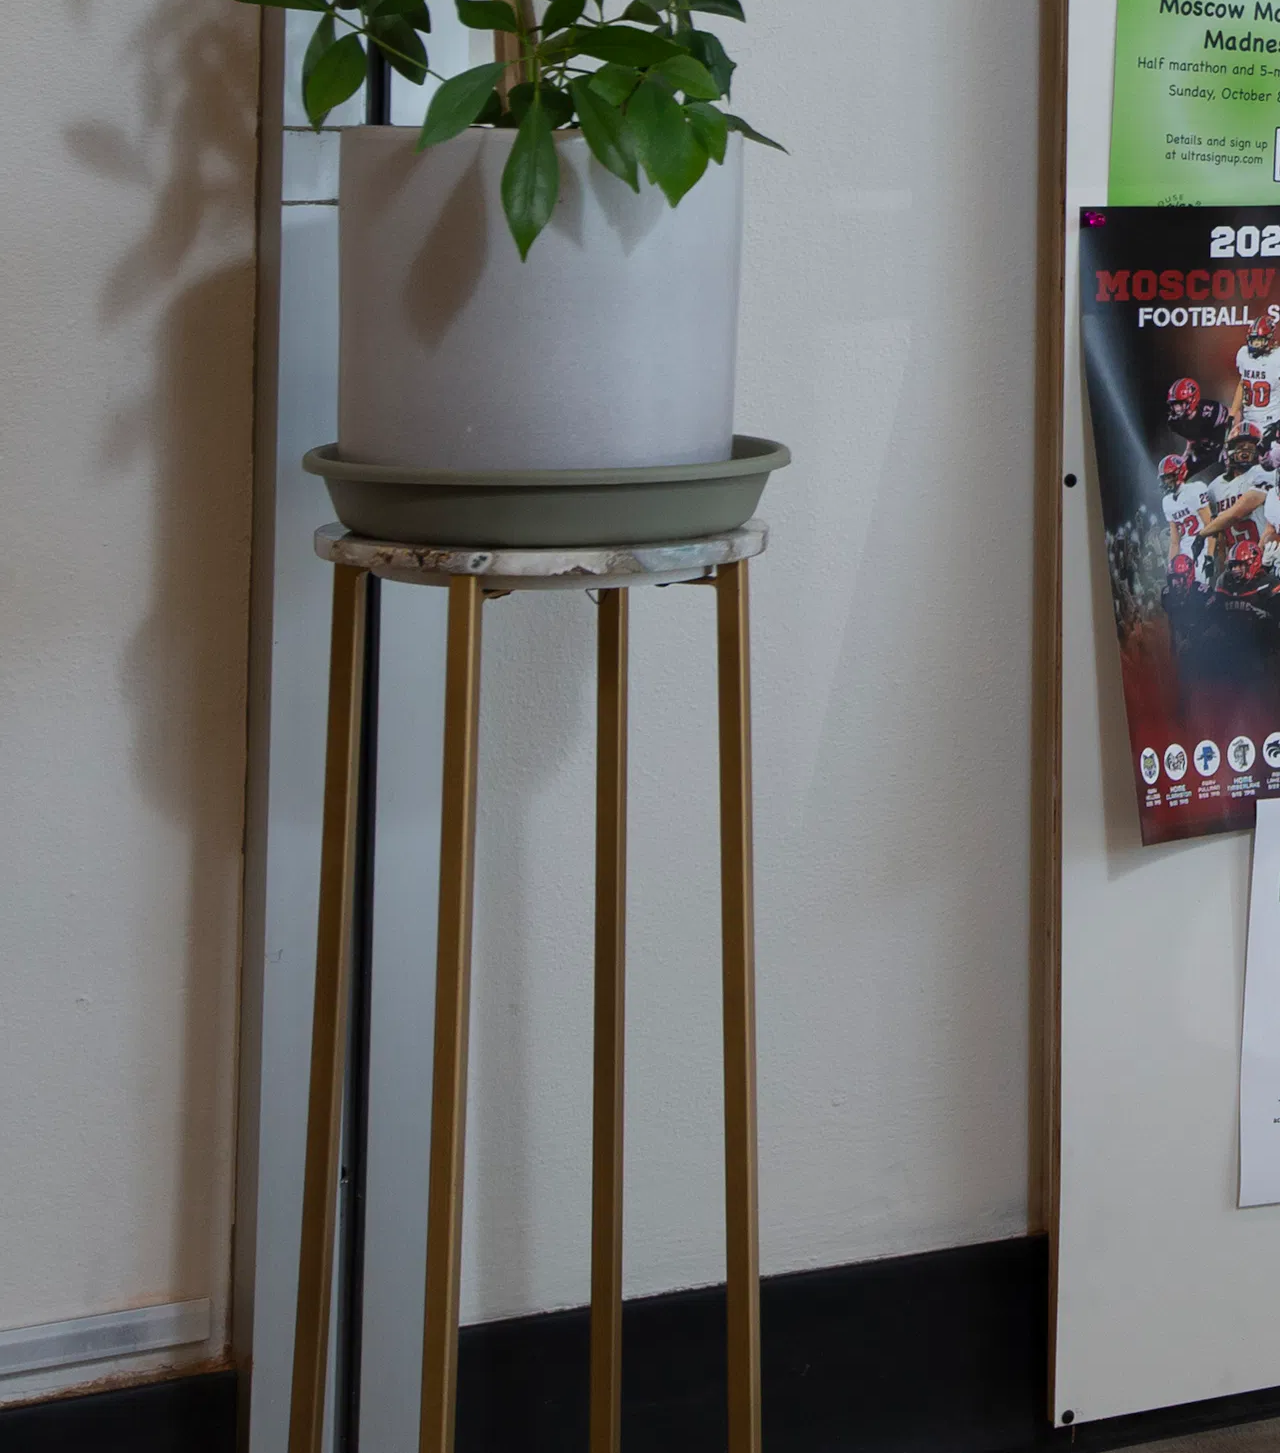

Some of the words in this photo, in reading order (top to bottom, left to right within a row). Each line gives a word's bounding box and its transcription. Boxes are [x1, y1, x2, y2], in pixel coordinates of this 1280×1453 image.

[1137, 56, 1164, 70] Half
[1169, 60, 1227, 75] marathon
[1232, 65, 1254, 75] and
[1095, 267, 1276, 304] MOSCOW
[1138, 304, 1255, 328] FOOTBALL
